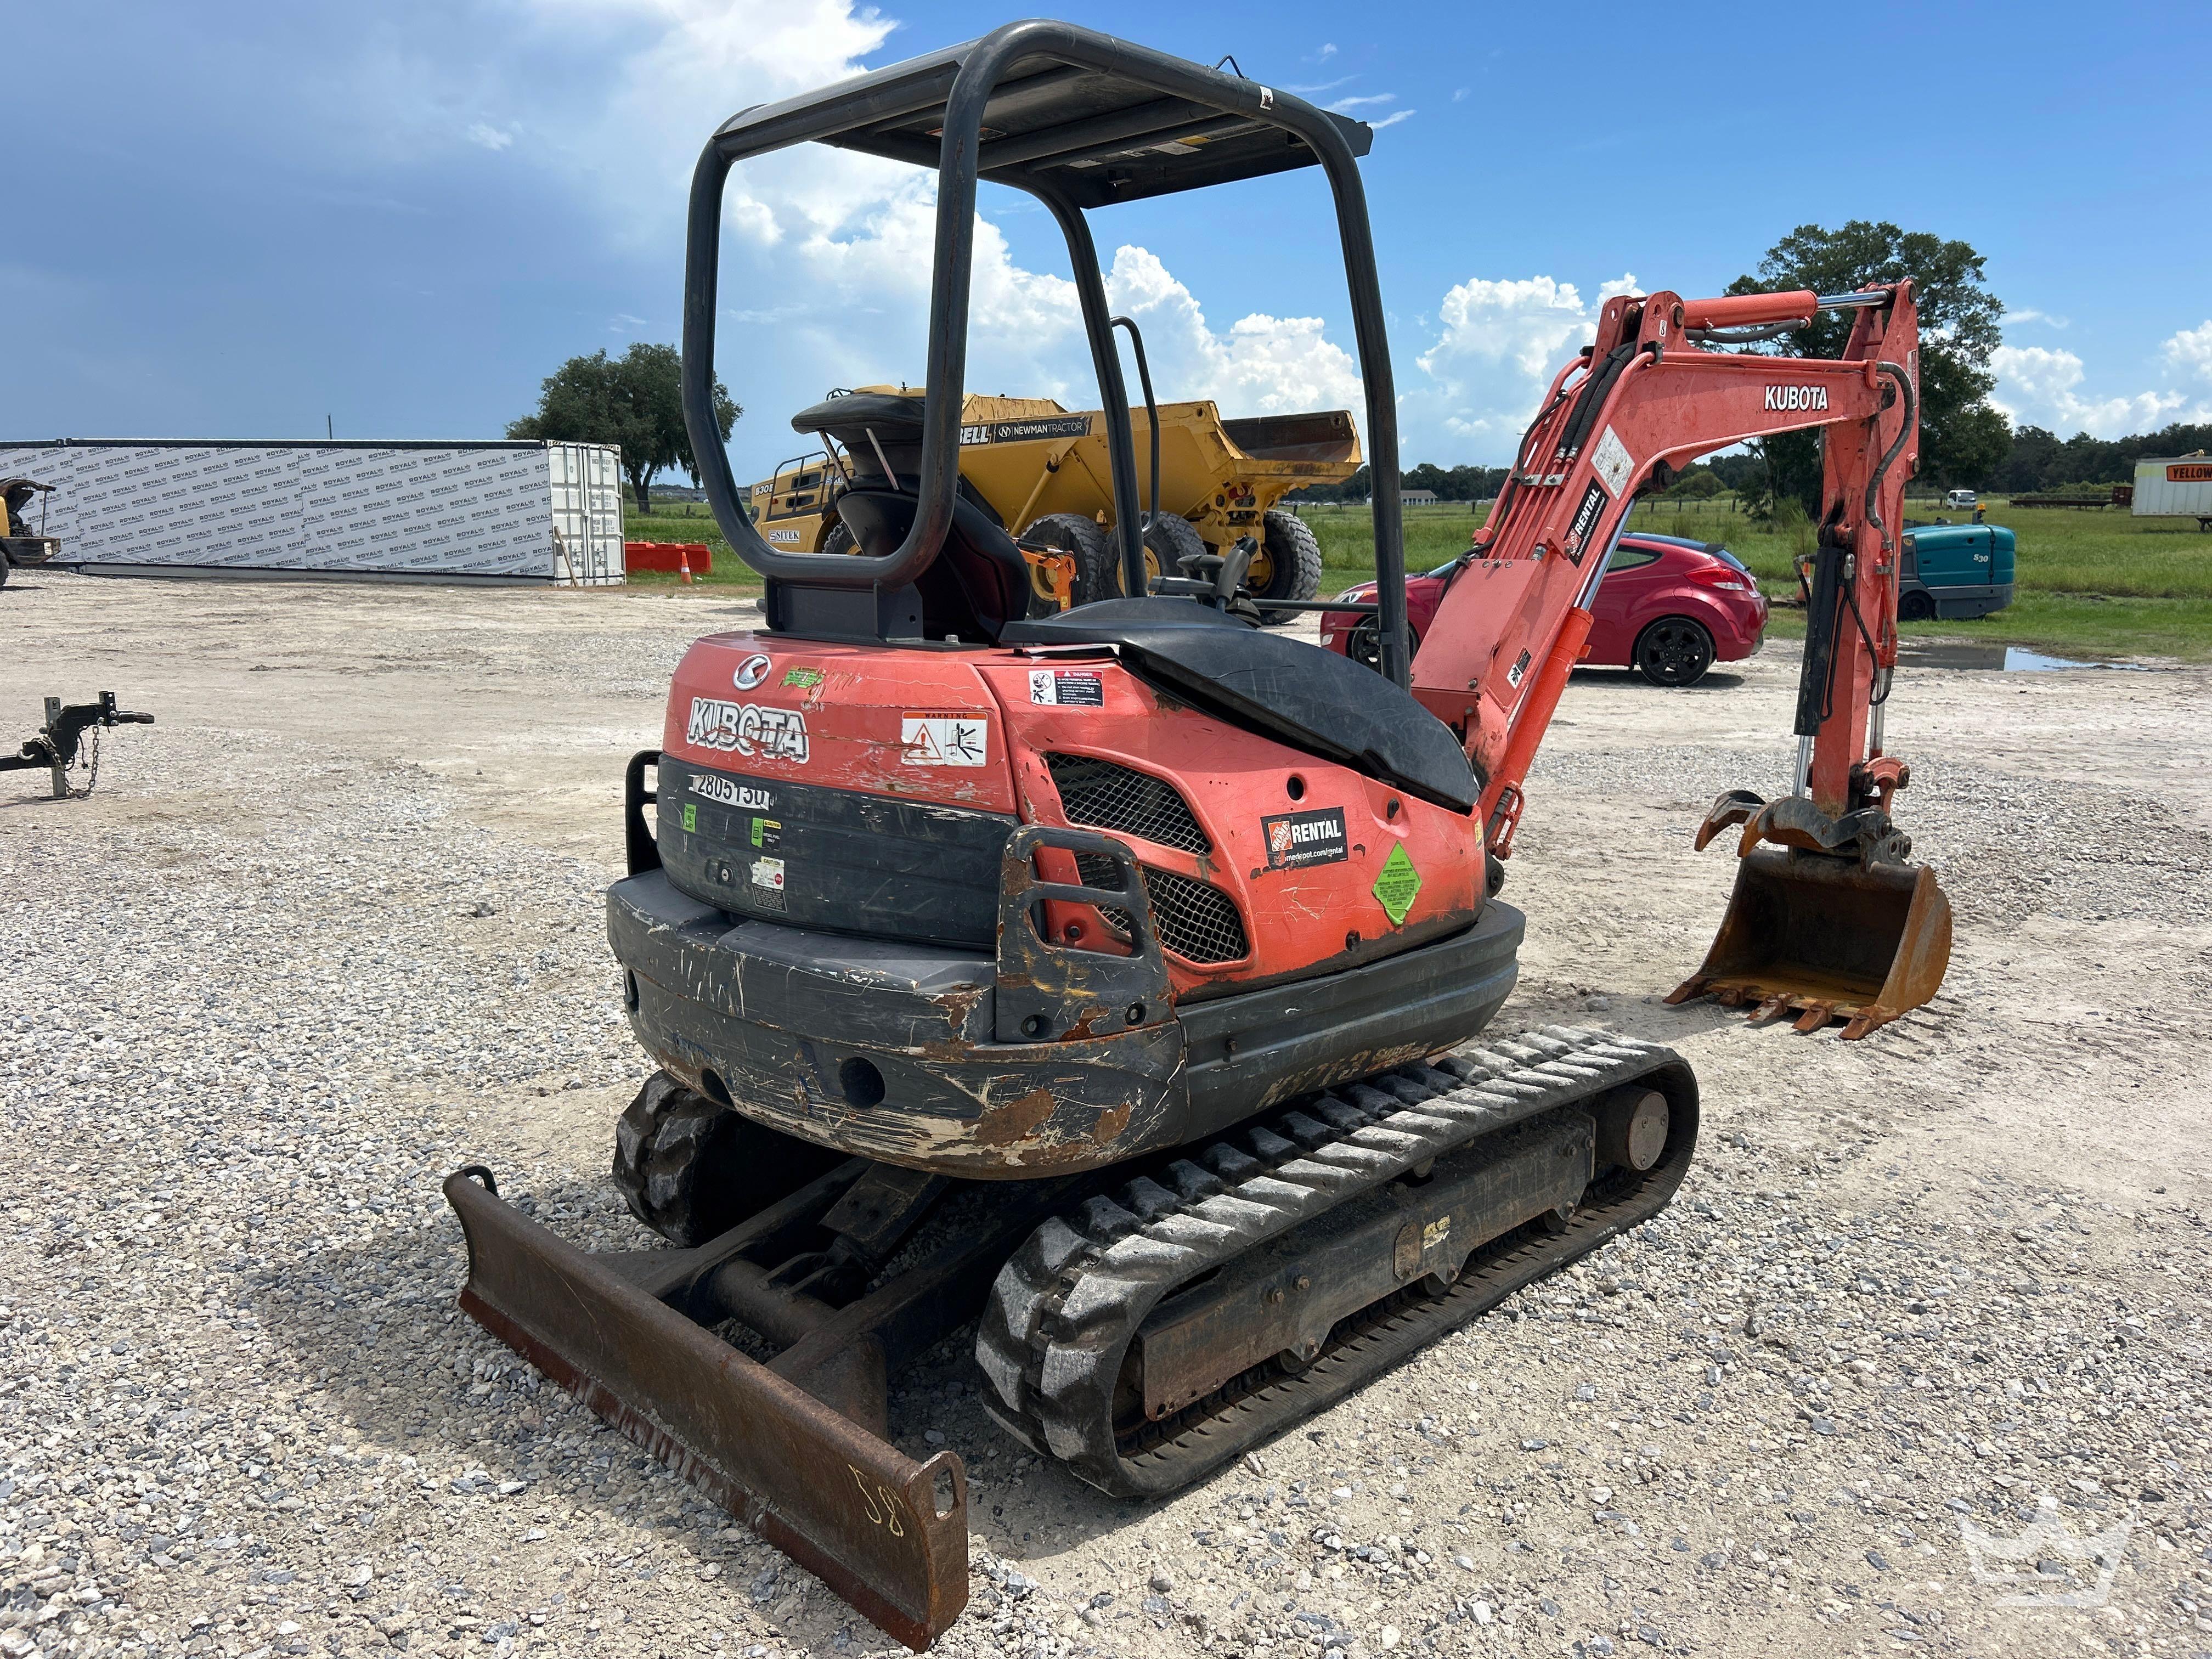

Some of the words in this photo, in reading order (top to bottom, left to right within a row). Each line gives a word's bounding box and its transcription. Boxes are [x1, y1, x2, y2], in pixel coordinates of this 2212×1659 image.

[1764, 385, 1829, 410] KUBOTA
[135, 449, 155, 457] ROYAL
[185, 452, 205, 460] ROYAL
[369, 450, 390, 459] ROYAL
[390, 462, 411, 471] ROYAL
[172, 471, 192, 479] ROYAL
[2173, 467, 2212, 479] YELLOW
[273, 479, 294, 487] ROYAL
[343, 489, 363, 498] ROYAL
[364, 501, 385, 509] ROYAL
[471, 510, 494, 518] ROYAL
[1575, 489, 1600, 535] RENTAL
[383, 513, 403, 521] ROYAL
[404, 524, 424, 533] ROYAL
[491, 522, 514, 531] ROYAL
[456, 529, 478, 538] ROYAL
[776, 531, 799, 539] SITEK
[424, 537, 443, 545] ROYAL
[357, 551, 376, 559] ROYAL
[533, 546, 552, 555] ROYA
[1973, 554, 1988, 562] S30
[463, 561, 485, 569] ROYAL
[689, 698, 806, 760] KUBOTA
[1272, 821, 1290, 851] HOME
[1291, 820, 1341, 843] RENTAL
